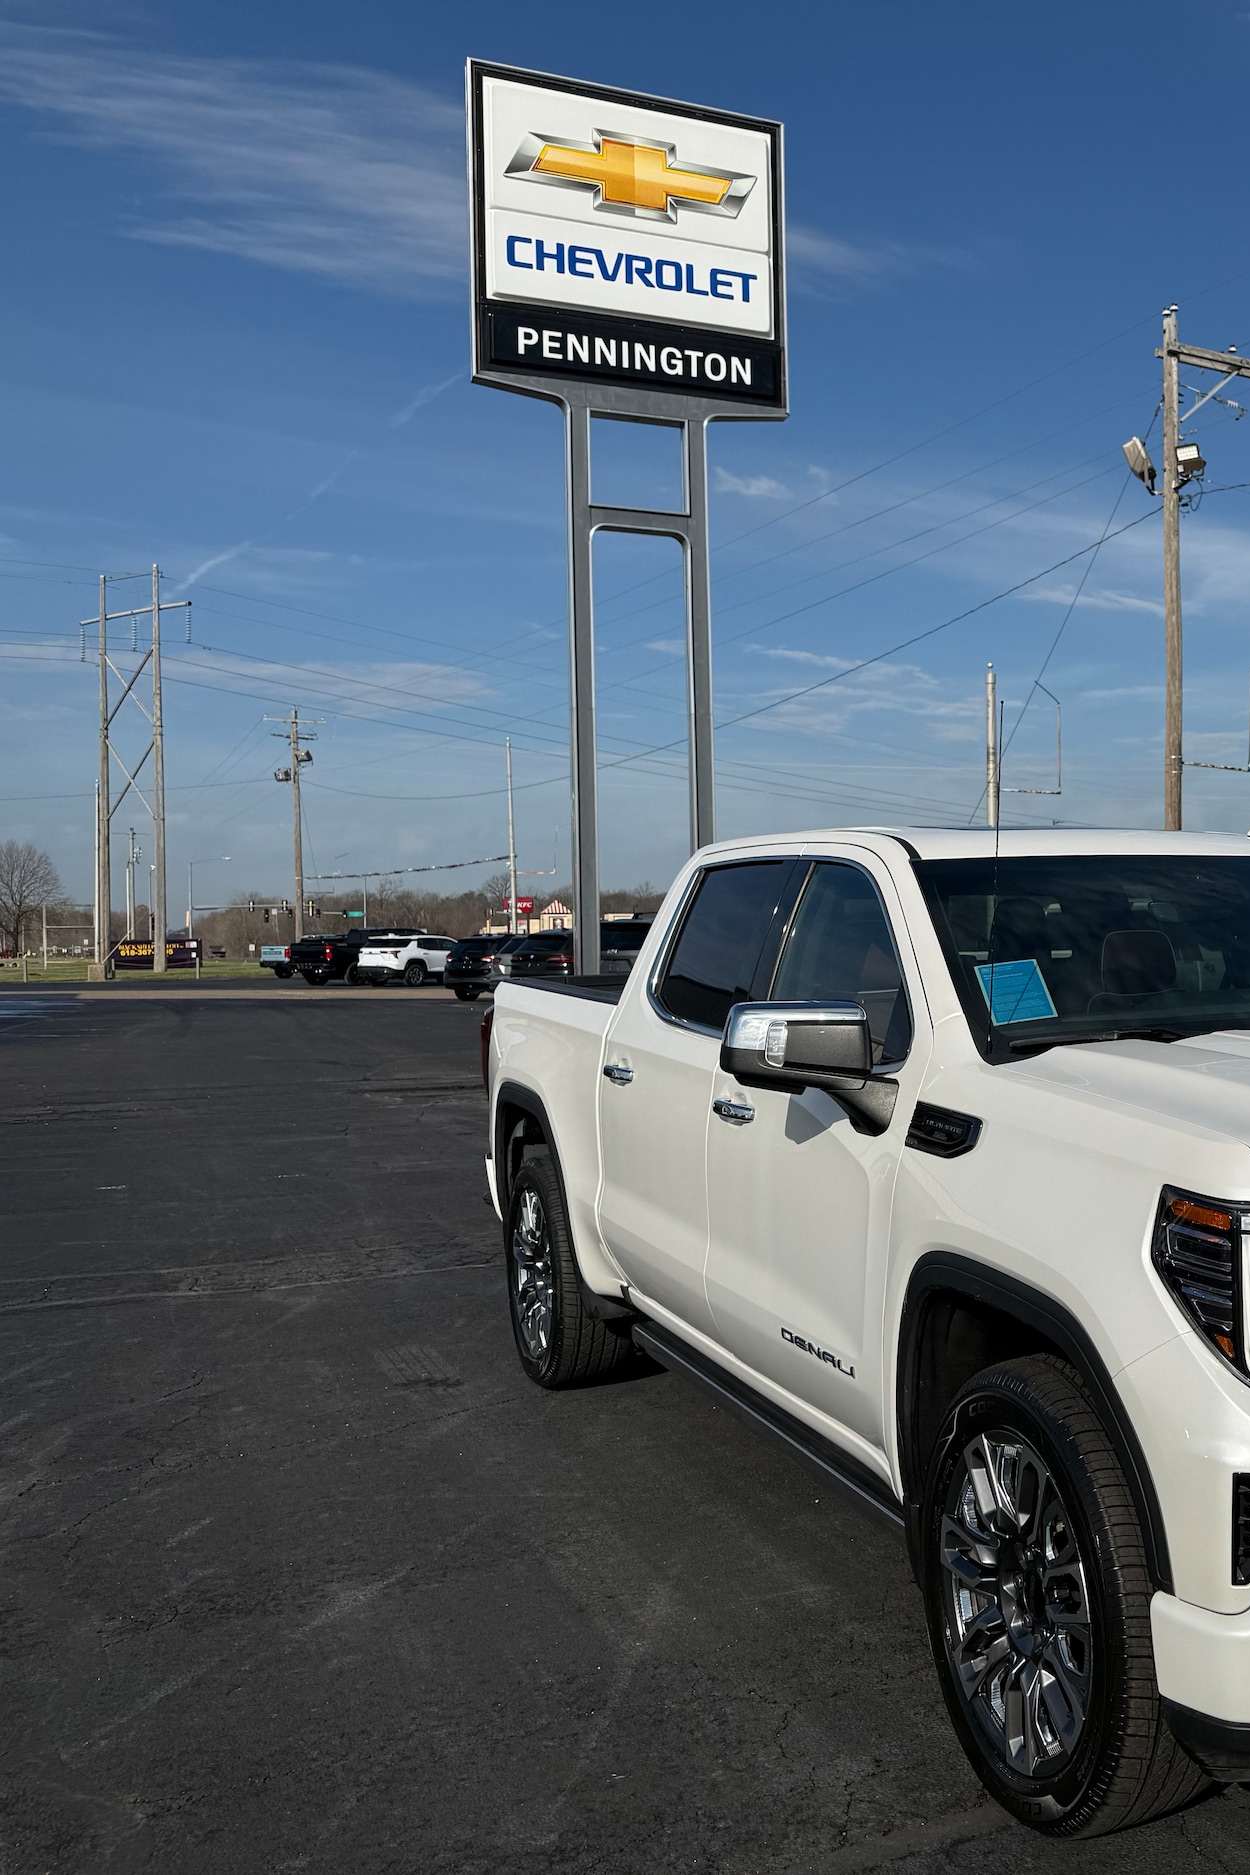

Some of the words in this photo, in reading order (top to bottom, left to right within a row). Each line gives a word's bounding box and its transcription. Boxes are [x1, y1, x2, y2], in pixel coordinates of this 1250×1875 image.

[507, 235, 757, 302] CHEVROLET
[517, 326, 752, 385] PENNINGTON
[780, 1327, 856, 1379] DENALI
